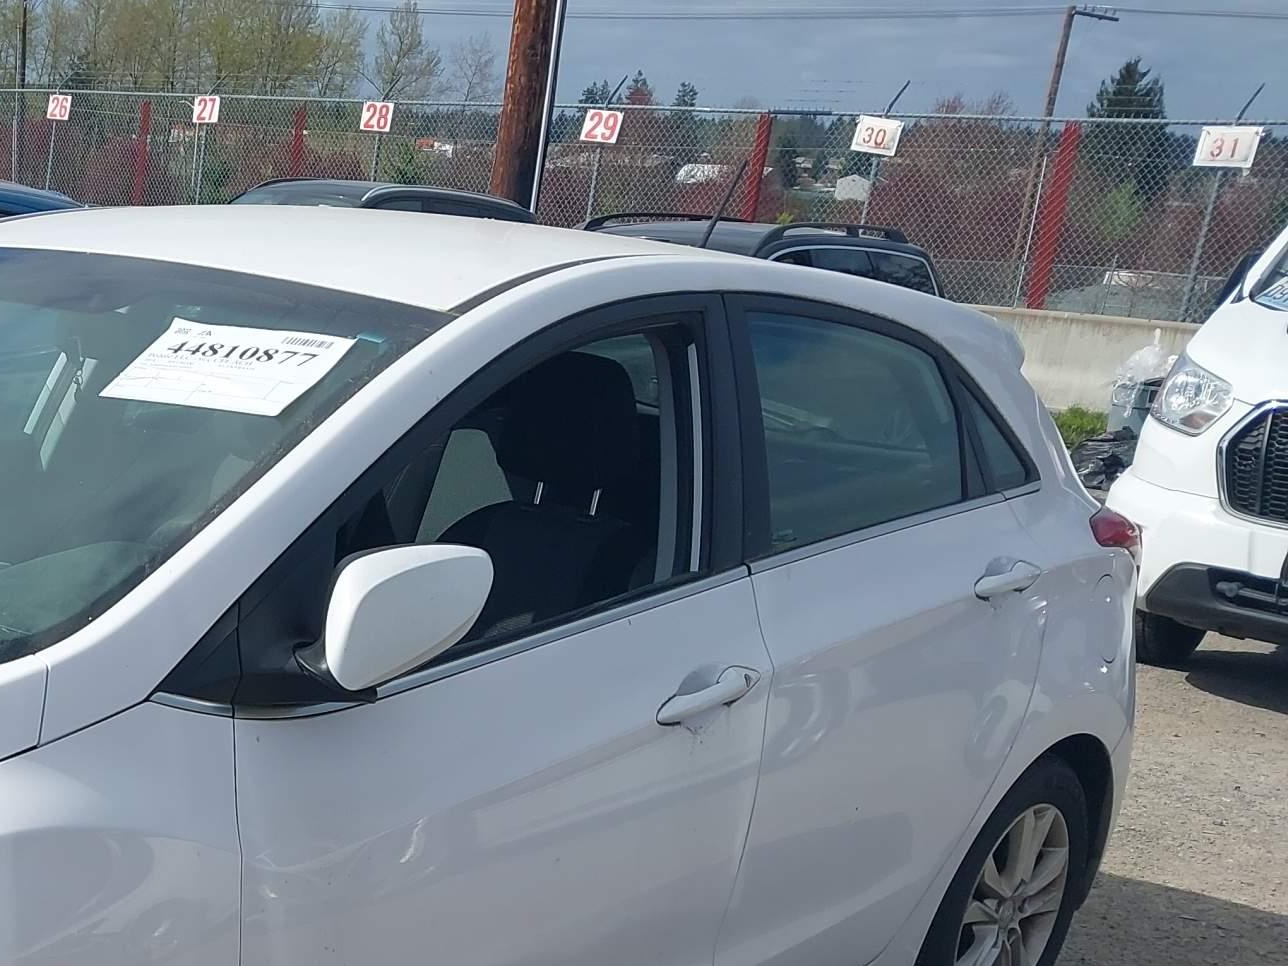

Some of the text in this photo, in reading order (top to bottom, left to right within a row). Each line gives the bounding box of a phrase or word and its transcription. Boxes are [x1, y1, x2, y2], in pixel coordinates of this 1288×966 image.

[50, 97, 69, 118] 26
[196, 97, 216, 121] 27
[363, 104, 390, 129] 28
[584, 112, 618, 141] 29
[863, 126, 886, 146] 30
[1210, 137, 1239, 158] 31
[167, 340, 319, 367] 44810877
